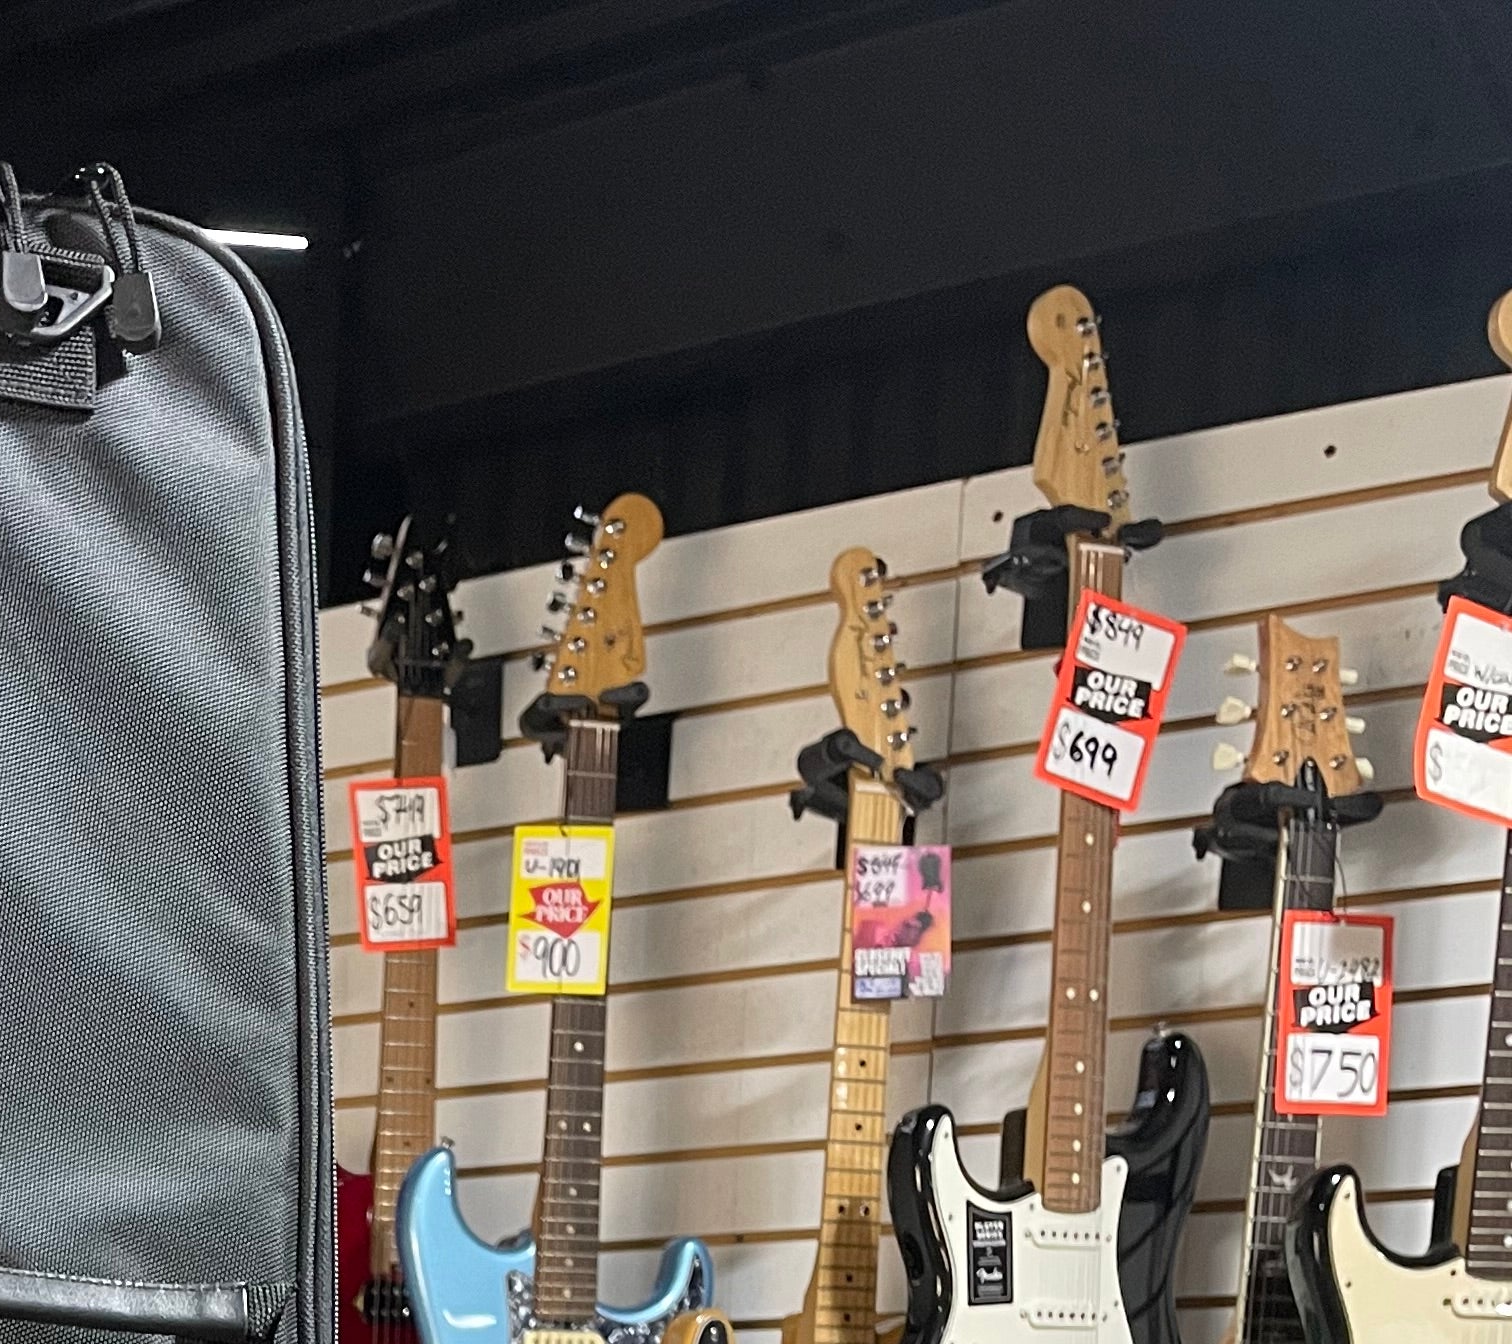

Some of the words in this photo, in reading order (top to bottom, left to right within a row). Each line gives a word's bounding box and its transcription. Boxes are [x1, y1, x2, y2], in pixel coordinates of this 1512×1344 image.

[1088, 671, 1138, 698] OUR
[1074, 687, 1146, 718] PRICE
[1456, 687, 1510, 714] OUR
[1052, 721, 1118, 778] $699
[377, 839, 422, 861] OUR
[372, 851, 434, 879] PRICE
[541, 887, 582, 907] OUR
[535, 904, 587, 923] PRICE
[1308, 983, 1361, 1007] OUR
[1300, 1000, 1372, 1028] PRICE
